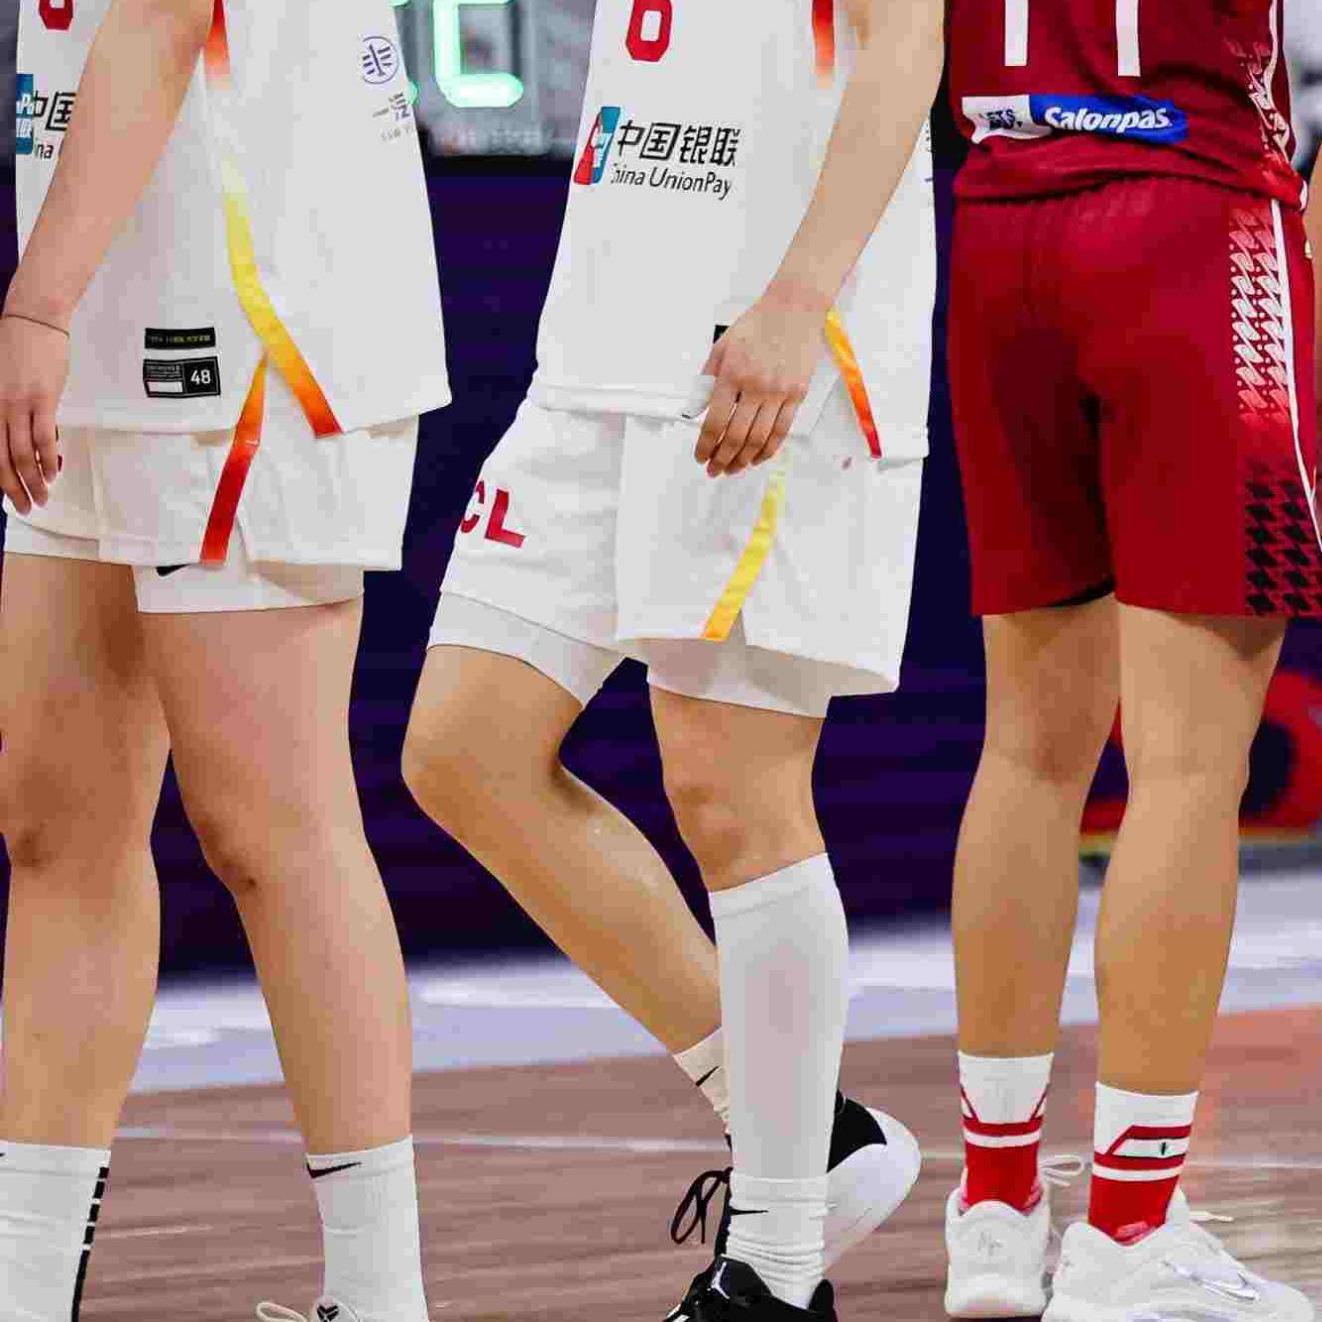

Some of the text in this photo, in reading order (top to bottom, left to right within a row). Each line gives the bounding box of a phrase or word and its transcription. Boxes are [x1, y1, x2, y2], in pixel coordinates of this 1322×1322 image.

[1044, 107, 1170, 133] Salonpas
[617, 119, 741, 167] 中国银联
[190, 369, 211, 385] 48
